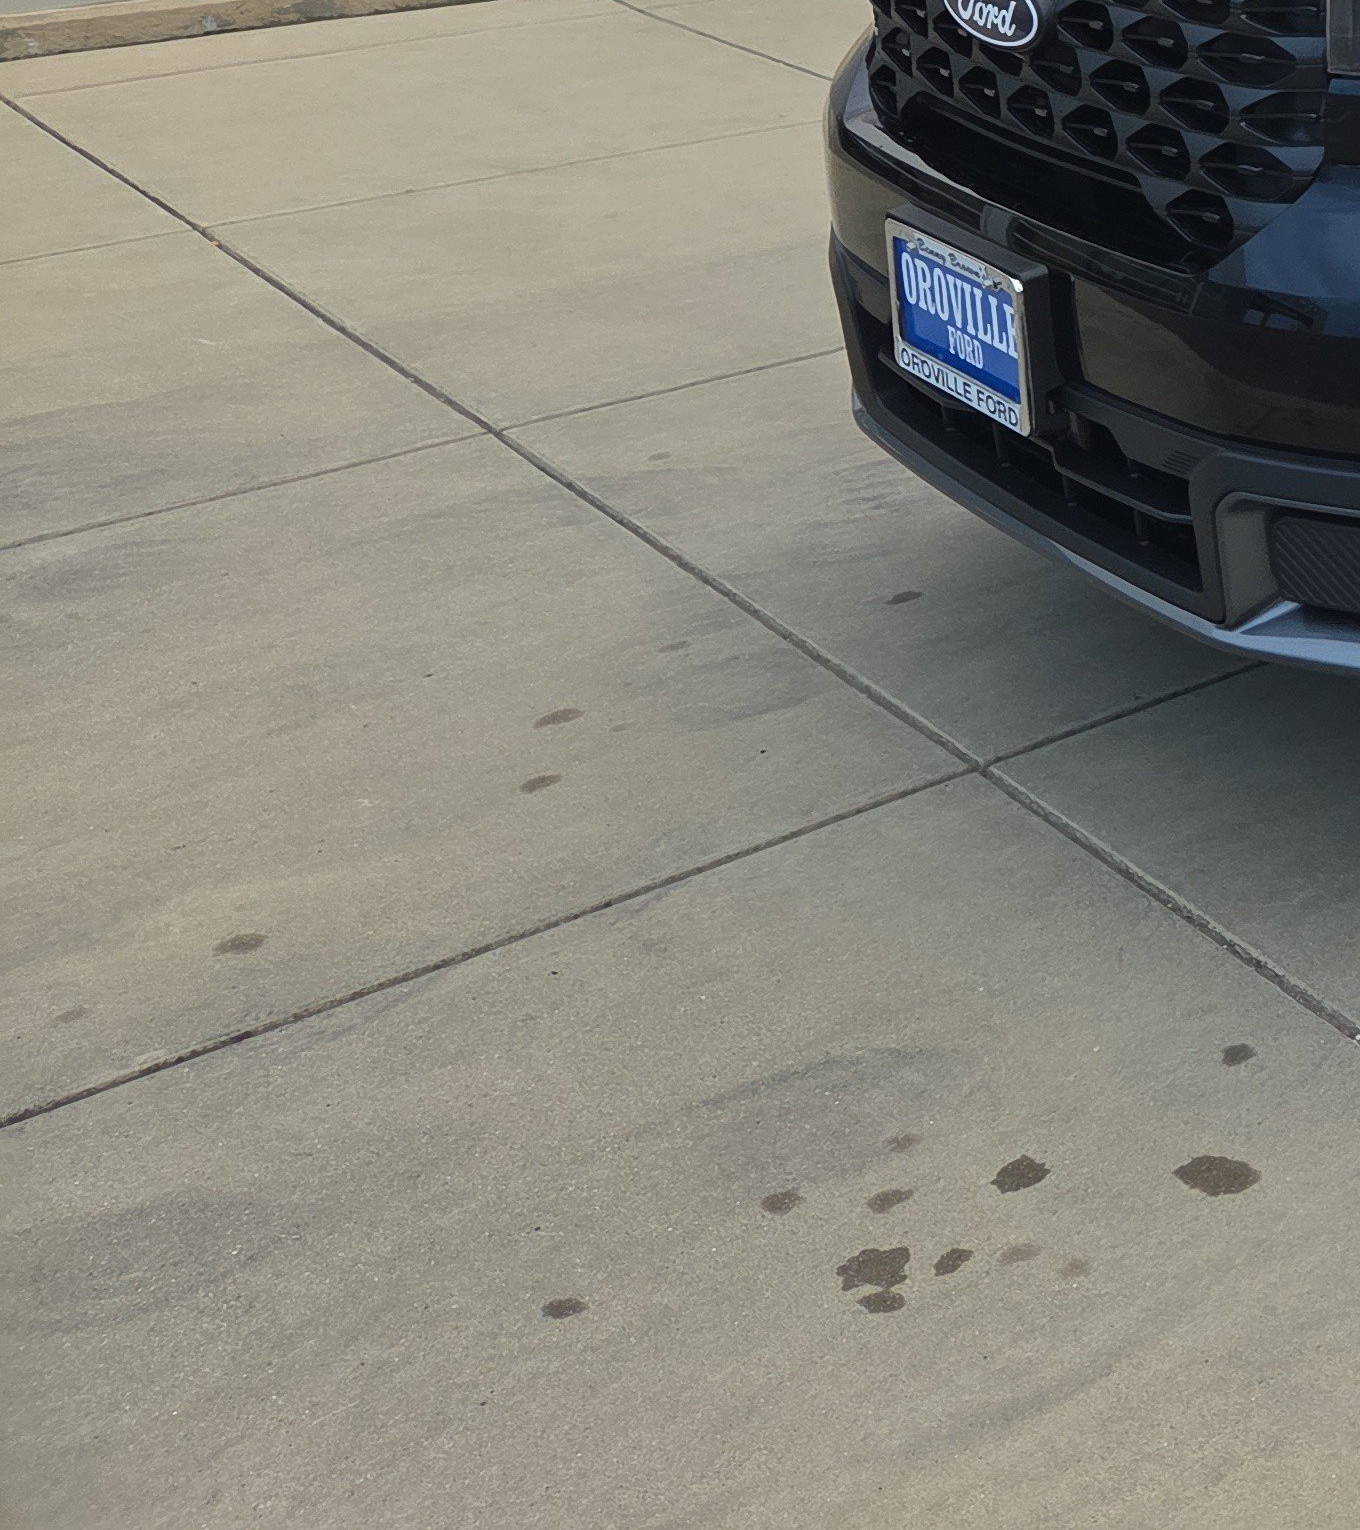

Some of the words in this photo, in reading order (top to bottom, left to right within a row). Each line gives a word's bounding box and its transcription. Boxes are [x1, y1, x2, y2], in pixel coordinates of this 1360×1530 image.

[947, 325, 984, 370] FORD
[900, 348, 973, 399] OROVILLE
[976, 390, 1018, 428] FORD
